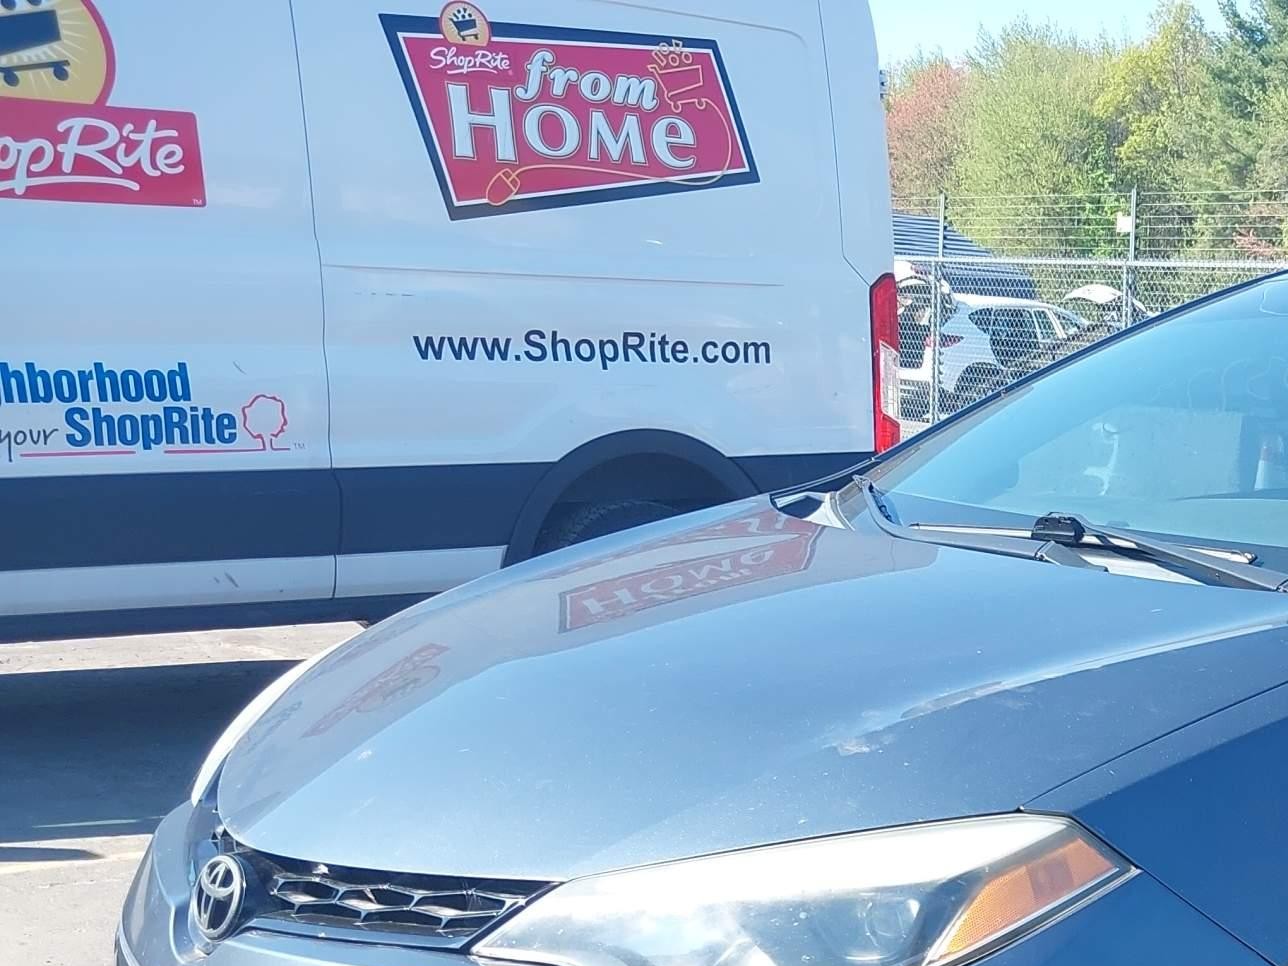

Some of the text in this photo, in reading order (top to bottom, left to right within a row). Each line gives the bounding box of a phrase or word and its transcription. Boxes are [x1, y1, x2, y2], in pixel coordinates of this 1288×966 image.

[429, 46, 511, 75] ShopRite
[515, 49, 659, 111] from
[412, 329, 772, 370] www.ShopRite.com
[0, 407, 237, 463] your ShopRite
